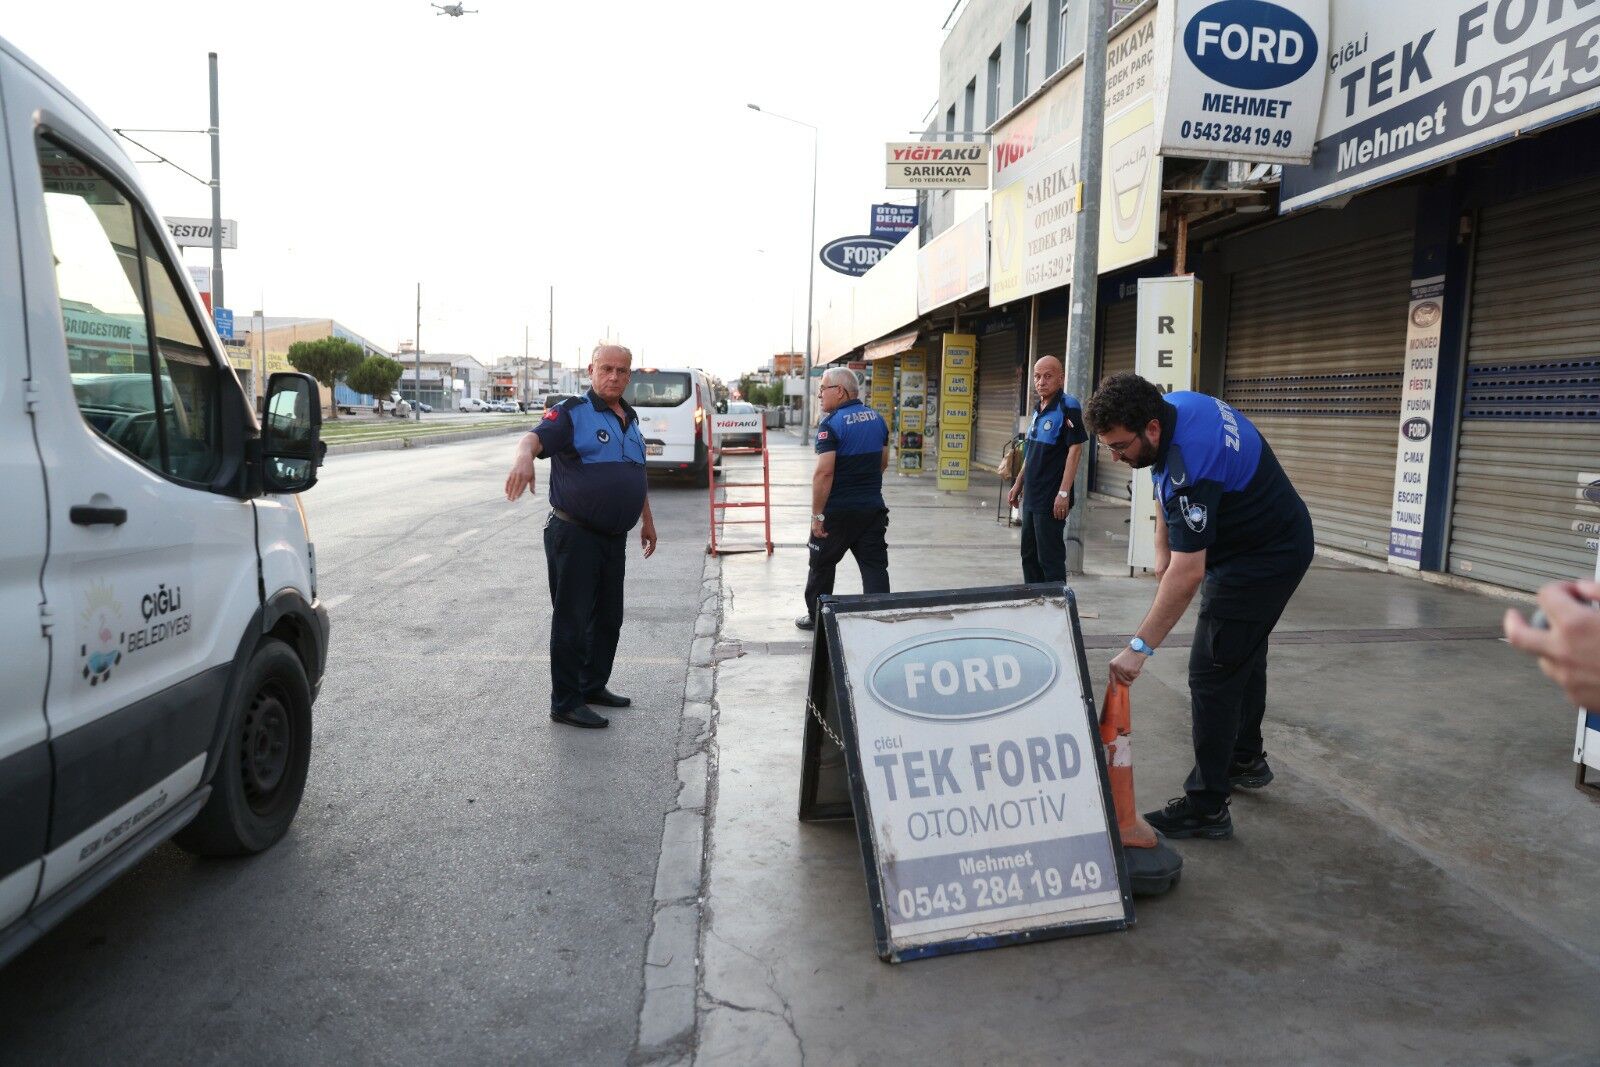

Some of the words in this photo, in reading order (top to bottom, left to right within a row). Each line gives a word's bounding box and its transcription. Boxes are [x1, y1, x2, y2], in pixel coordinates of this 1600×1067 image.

[1108, 20, 1153, 70] RIKAYA
[1196, 21, 1304, 65] FORD
[1330, 32, 1368, 74] ÇİĞLİ
[1131, 50, 1153, 74] PARÇ
[1340, 28, 1437, 118] TEK
[1202, 93, 1292, 119] MEHMET
[1337, 101, 1447, 172] Mehmet
[1461, 24, 1600, 127] 0543
[1223, 125, 1251, 144] 284
[1255, 128, 1271, 146] 19
[1273, 130, 1292, 148] 49
[904, 166, 971, 176] SARIKAYA
[1027, 163, 1077, 208] SARIKA
[1035, 197, 1075, 230] OTOMOT
[64, 316, 132, 339] BRIDGESTONE
[1410, 337, 1437, 350] MONDEO
[1411, 358, 1433, 370] FOCUS
[843, 410, 878, 425] ZABITA
[1408, 423, 1427, 437] FORD
[1404, 452, 1424, 464] C-MAX
[1403, 472, 1421, 484] KUGA
[1398, 491, 1423, 504] ESCORT
[1396, 511, 1421, 524] TAUNUS
[904, 654, 1021, 698] FORD
[874, 735, 902, 752] ÇİĞLİ
[873, 747, 962, 801] TEK
[969, 733, 1081, 791] FORD
[907, 790, 1065, 841] OTOMOTİV
[959, 850, 1033, 876] Mehmet
[898, 882, 967, 919] 0543
[972, 873, 1023, 907] 284
[1030, 868, 1062, 898] 19
[1070, 861, 1103, 891] 49
